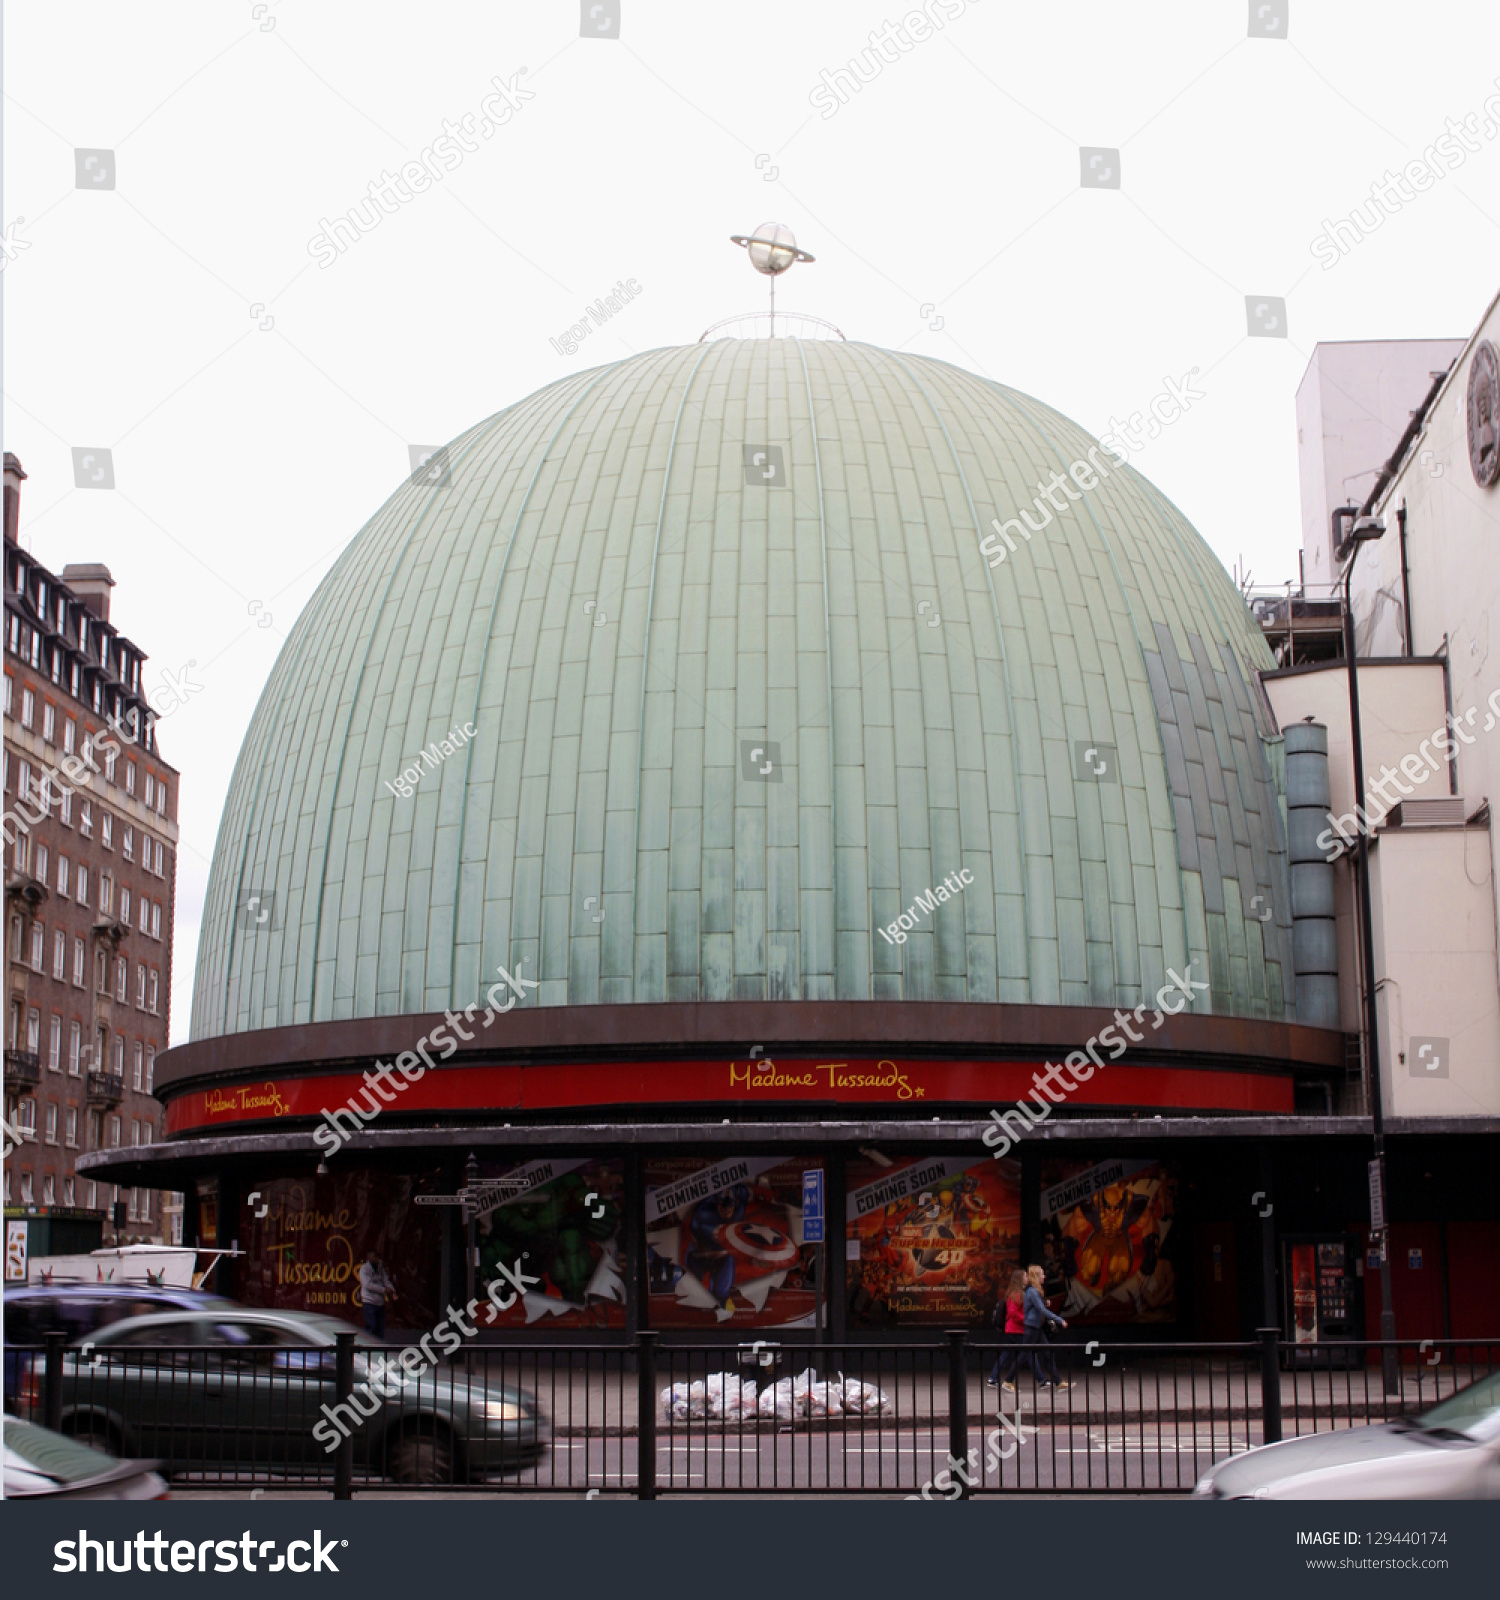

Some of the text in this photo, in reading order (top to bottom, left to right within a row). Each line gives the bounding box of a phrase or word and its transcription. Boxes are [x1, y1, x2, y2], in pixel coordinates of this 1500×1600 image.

[205, 1081, 283, 1117] Madame Tussauds
[729, 1060, 913, 1100] Madame Tussauds
[656, 1161, 748, 1213] COMING SOON
[856, 1161, 946, 1214] COMING SOON
[1048, 1180, 1092, 1213] COMING
[1094, 1163, 1124, 1189] SOON
[264, 1186, 358, 1239] Madame
[890, 1237, 978, 1248] SUPER HEROES
[934, 1250, 964, 1264] 4D
[306, 1291, 348, 1305] LONDON
